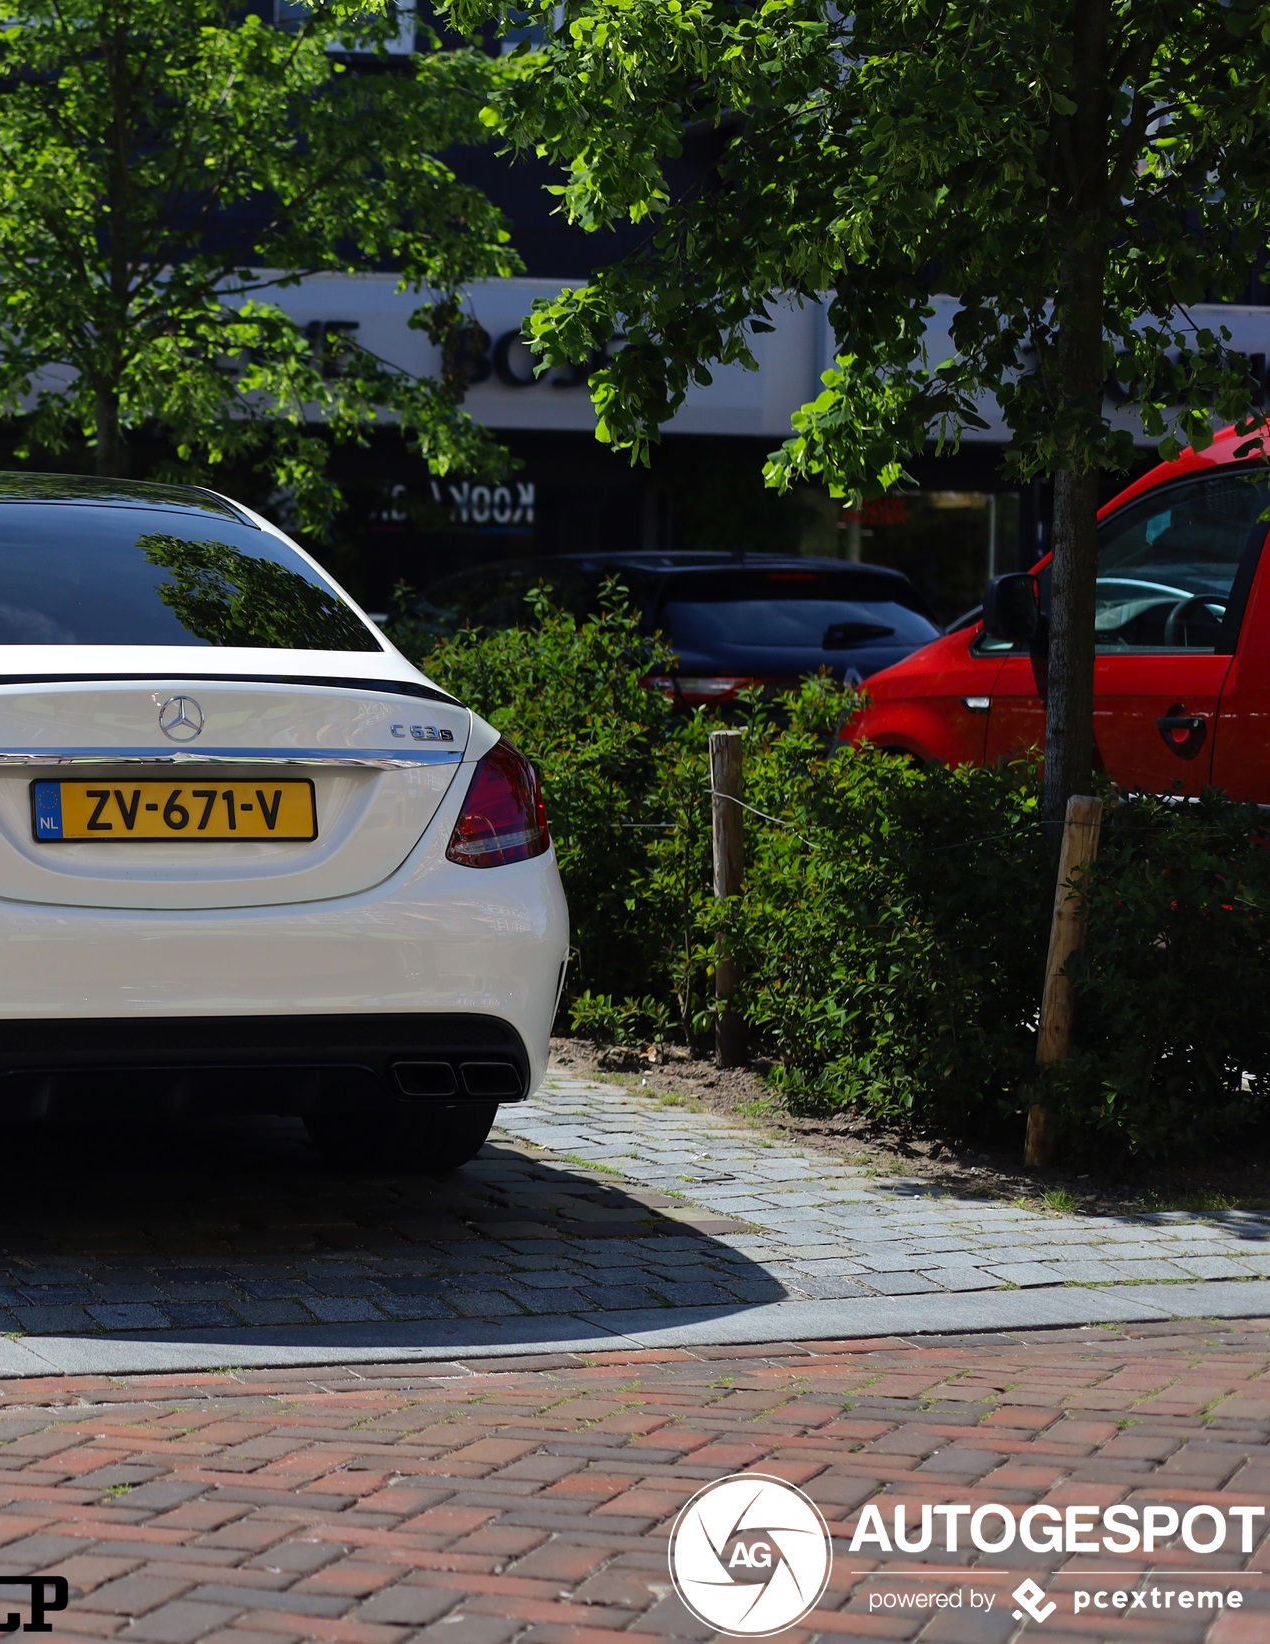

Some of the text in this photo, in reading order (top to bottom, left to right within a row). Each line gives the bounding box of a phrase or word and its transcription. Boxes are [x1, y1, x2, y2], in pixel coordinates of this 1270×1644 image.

[390, 724, 405, 738] C
[86, 788, 283, 831] ZV-671-V
[40, 817, 59, 830] NL
